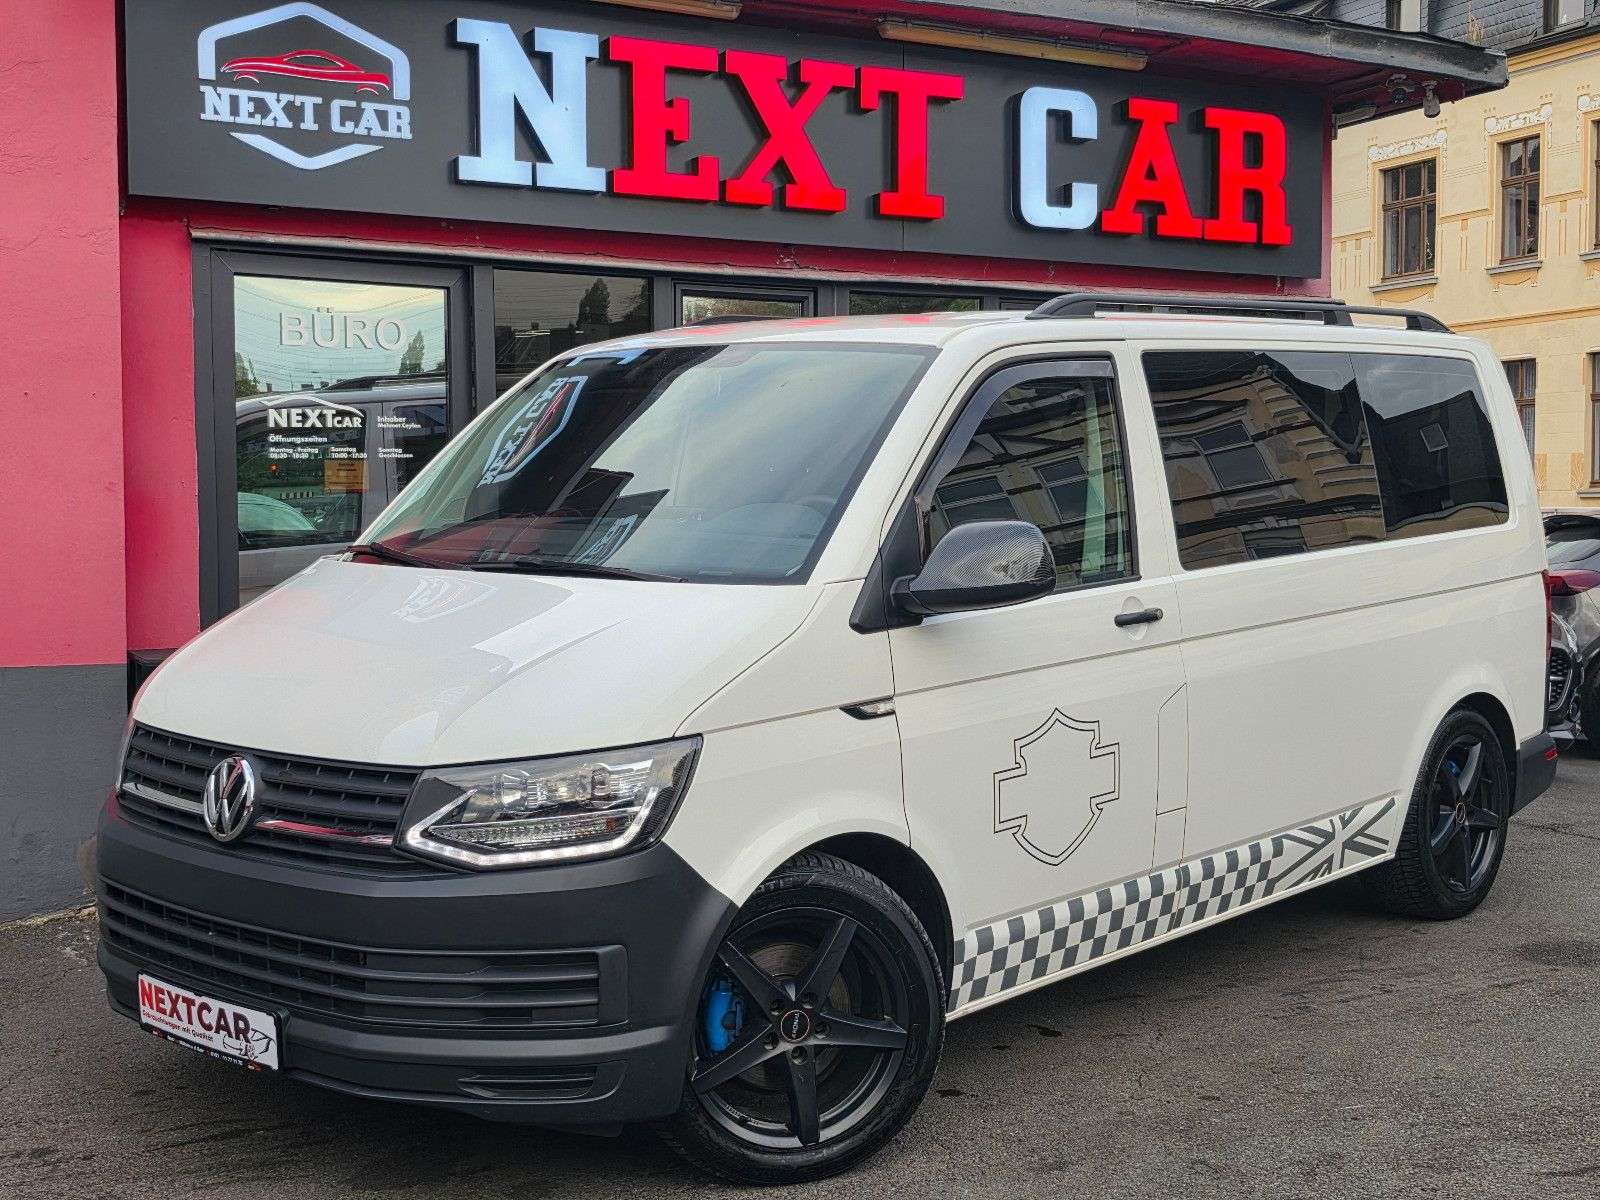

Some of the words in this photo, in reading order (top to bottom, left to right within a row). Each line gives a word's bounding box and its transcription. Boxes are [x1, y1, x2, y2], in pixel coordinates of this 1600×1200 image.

[200, 86, 322, 131] NEXT
[331, 100, 412, 140] CAR
[456, 17, 964, 220] NEXT
[1019, 86, 1293, 246] CAR
[280, 306, 405, 350] BÜRO
[268, 433, 328, 444] Öffnungszeiten
[377, 415, 406, 423] Inhaber
[297, 446, 319, 454] Freitag
[140, 979, 251, 1045] NEXTCAR
